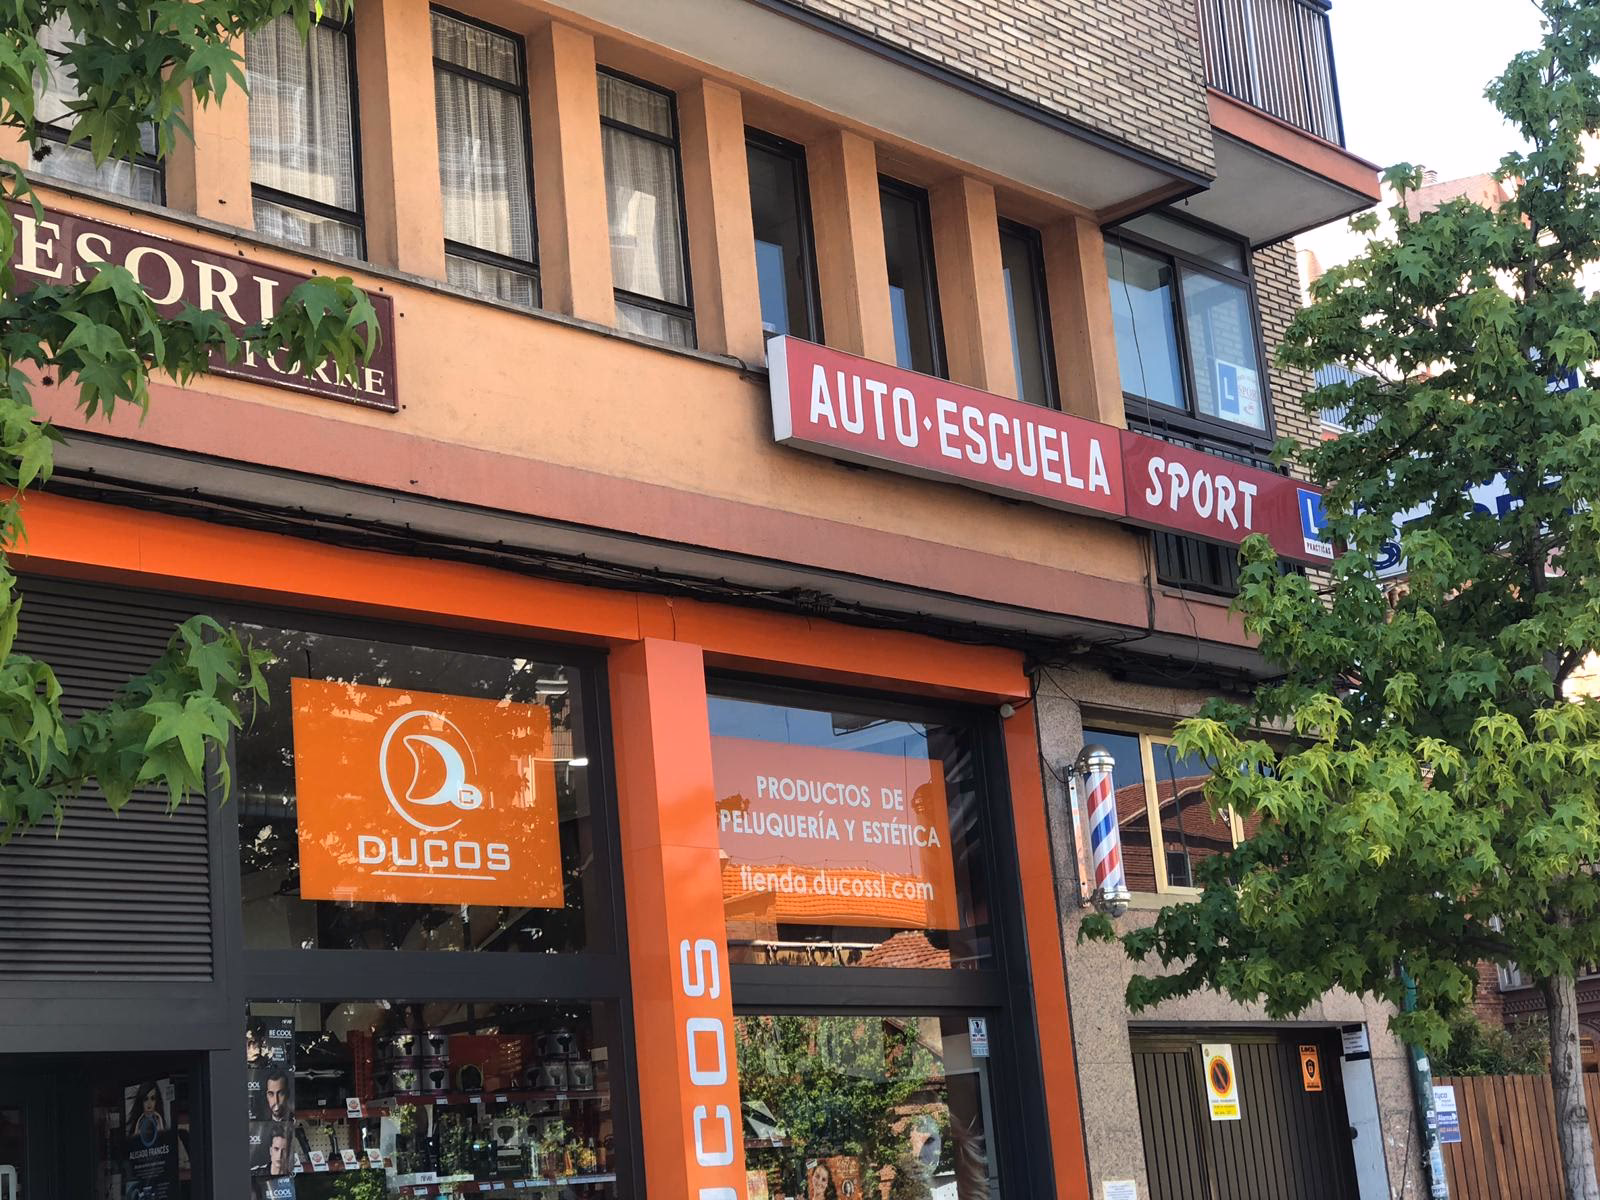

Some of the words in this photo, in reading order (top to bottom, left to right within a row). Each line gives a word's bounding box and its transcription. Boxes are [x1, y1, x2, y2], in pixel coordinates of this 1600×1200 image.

[6, 212, 282, 326] ESORI
[1145, 457, 1258, 530] SPORT
[756, 775, 871, 809] PRODUCTOS
[881, 787, 904, 811] DE
[719, 808, 840, 841] PELUQUERÍA
[844, 819, 856, 841] Y
[863, 816, 941, 848] ESTÉTICA
[357, 835, 511, 870] DUCOS
